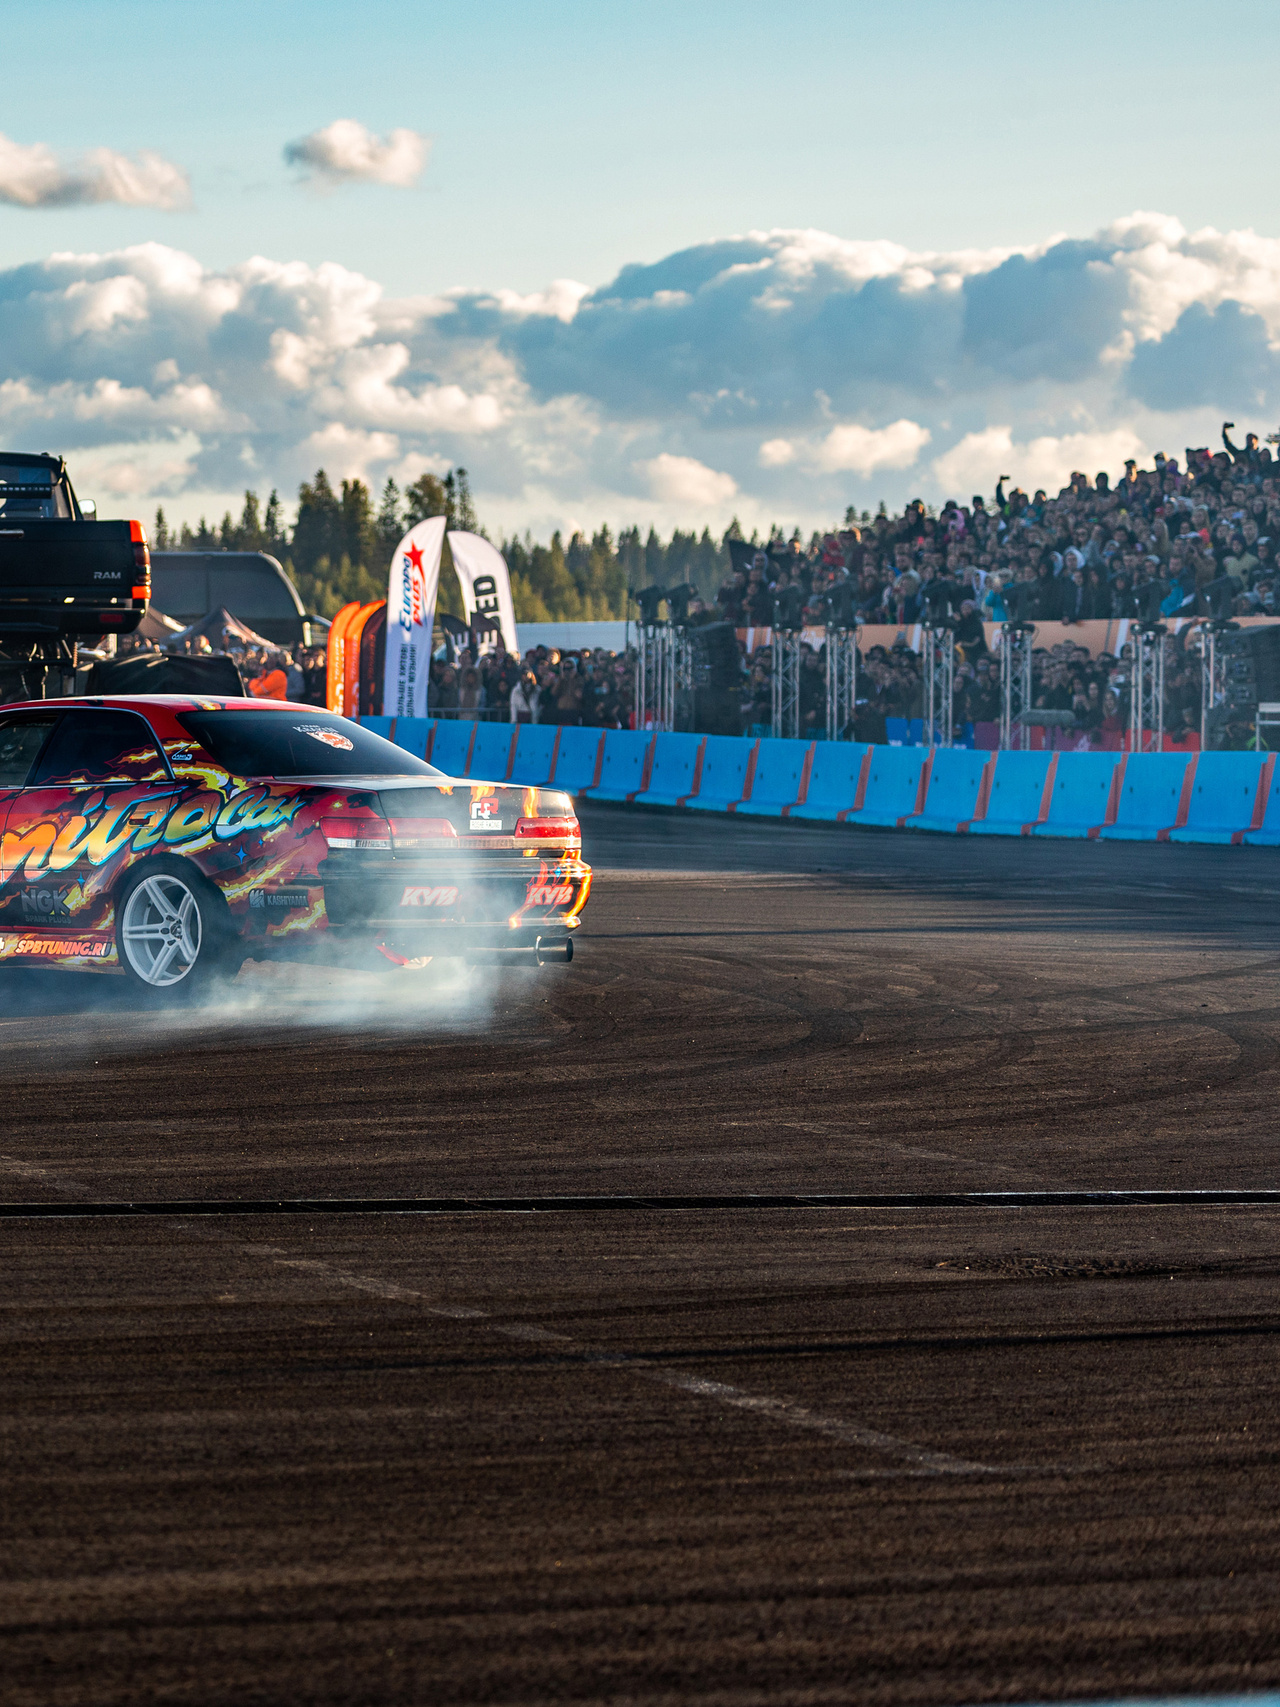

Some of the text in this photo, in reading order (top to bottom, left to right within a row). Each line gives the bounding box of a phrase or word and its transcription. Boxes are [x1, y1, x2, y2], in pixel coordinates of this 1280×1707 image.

[93, 571, 122, 580] RAM
[21, 888, 71, 914] NGK
[267, 895, 309, 906] KASHIYAMA
[400, 887, 458, 906] KYB
[526, 885, 573, 905] KYB
[25, 914, 70, 924] SPARK PLUGS
[15, 939, 112, 957] SPBTUNING.RU
